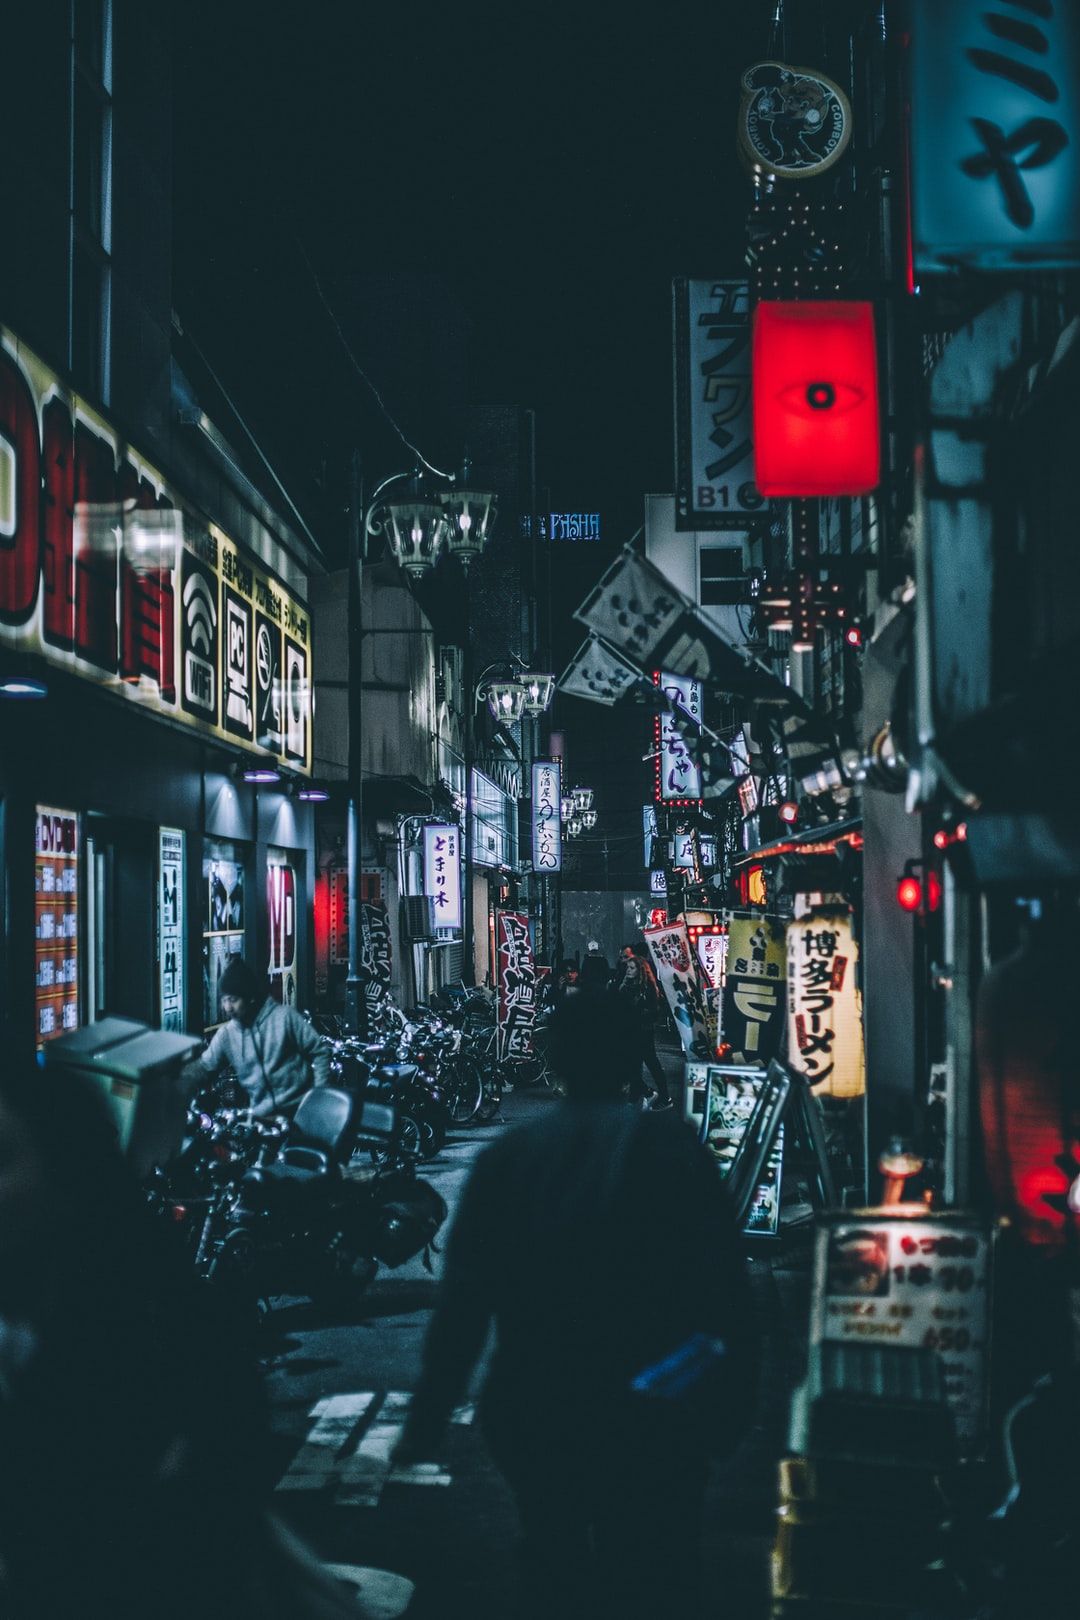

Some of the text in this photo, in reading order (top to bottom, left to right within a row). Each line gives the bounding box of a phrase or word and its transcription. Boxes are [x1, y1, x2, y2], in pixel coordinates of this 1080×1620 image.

[824, 104, 842, 153] COWBOY
[550, 513, 600, 540] PASHA
[231, 620, 244, 668] PC
[434, 836, 449, 908] とまり木
[800, 929, 839, 1086] 博多ラーメン
